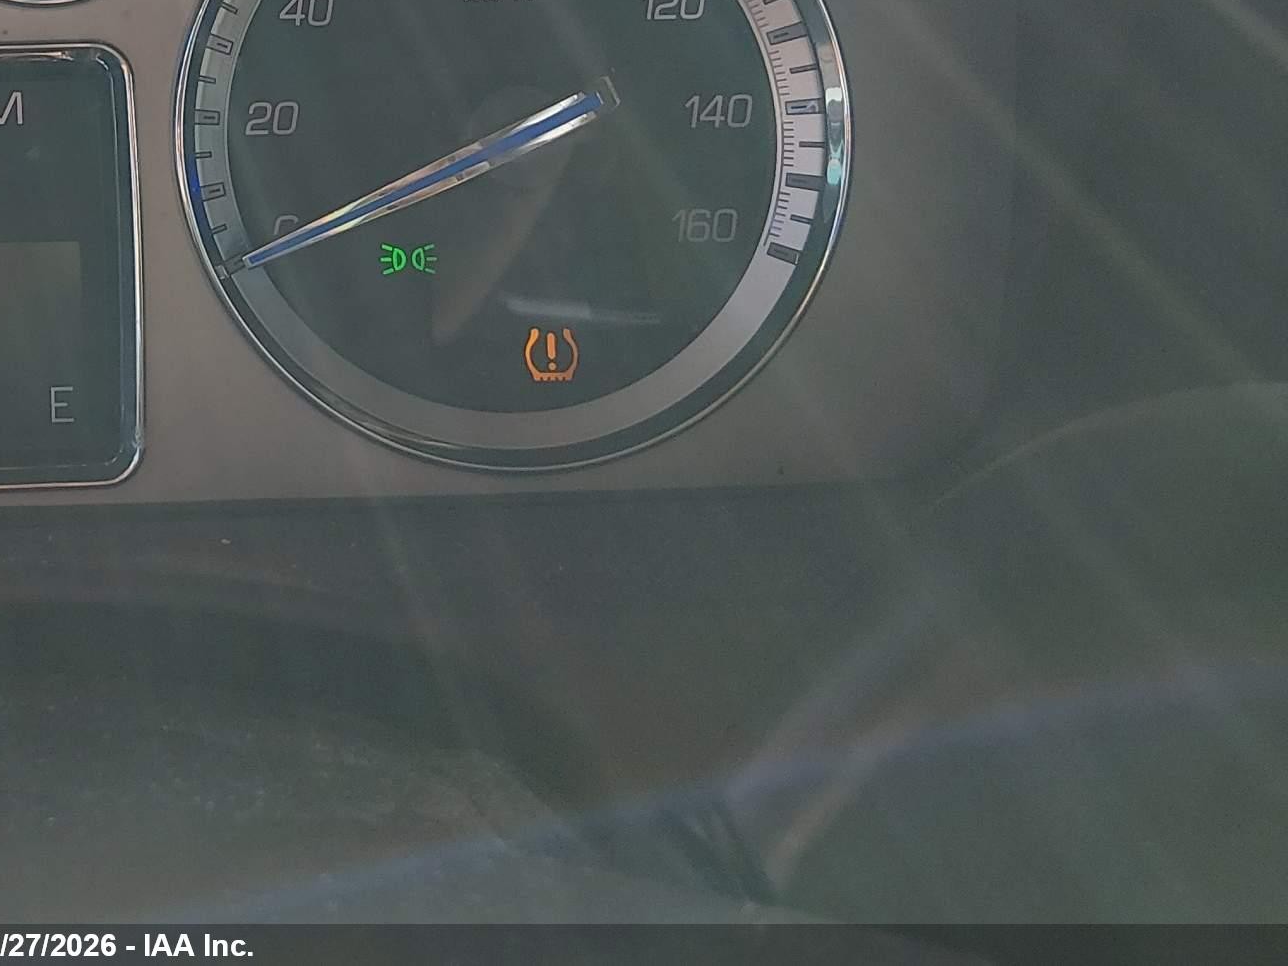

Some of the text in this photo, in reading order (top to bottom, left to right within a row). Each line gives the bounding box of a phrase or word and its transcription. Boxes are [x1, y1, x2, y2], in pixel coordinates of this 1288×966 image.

[245, 102, 298, 135] 20
[684, 94, 752, 128] 140
[671, 209, 737, 243] 160
[50, 386, 74, 423] E
